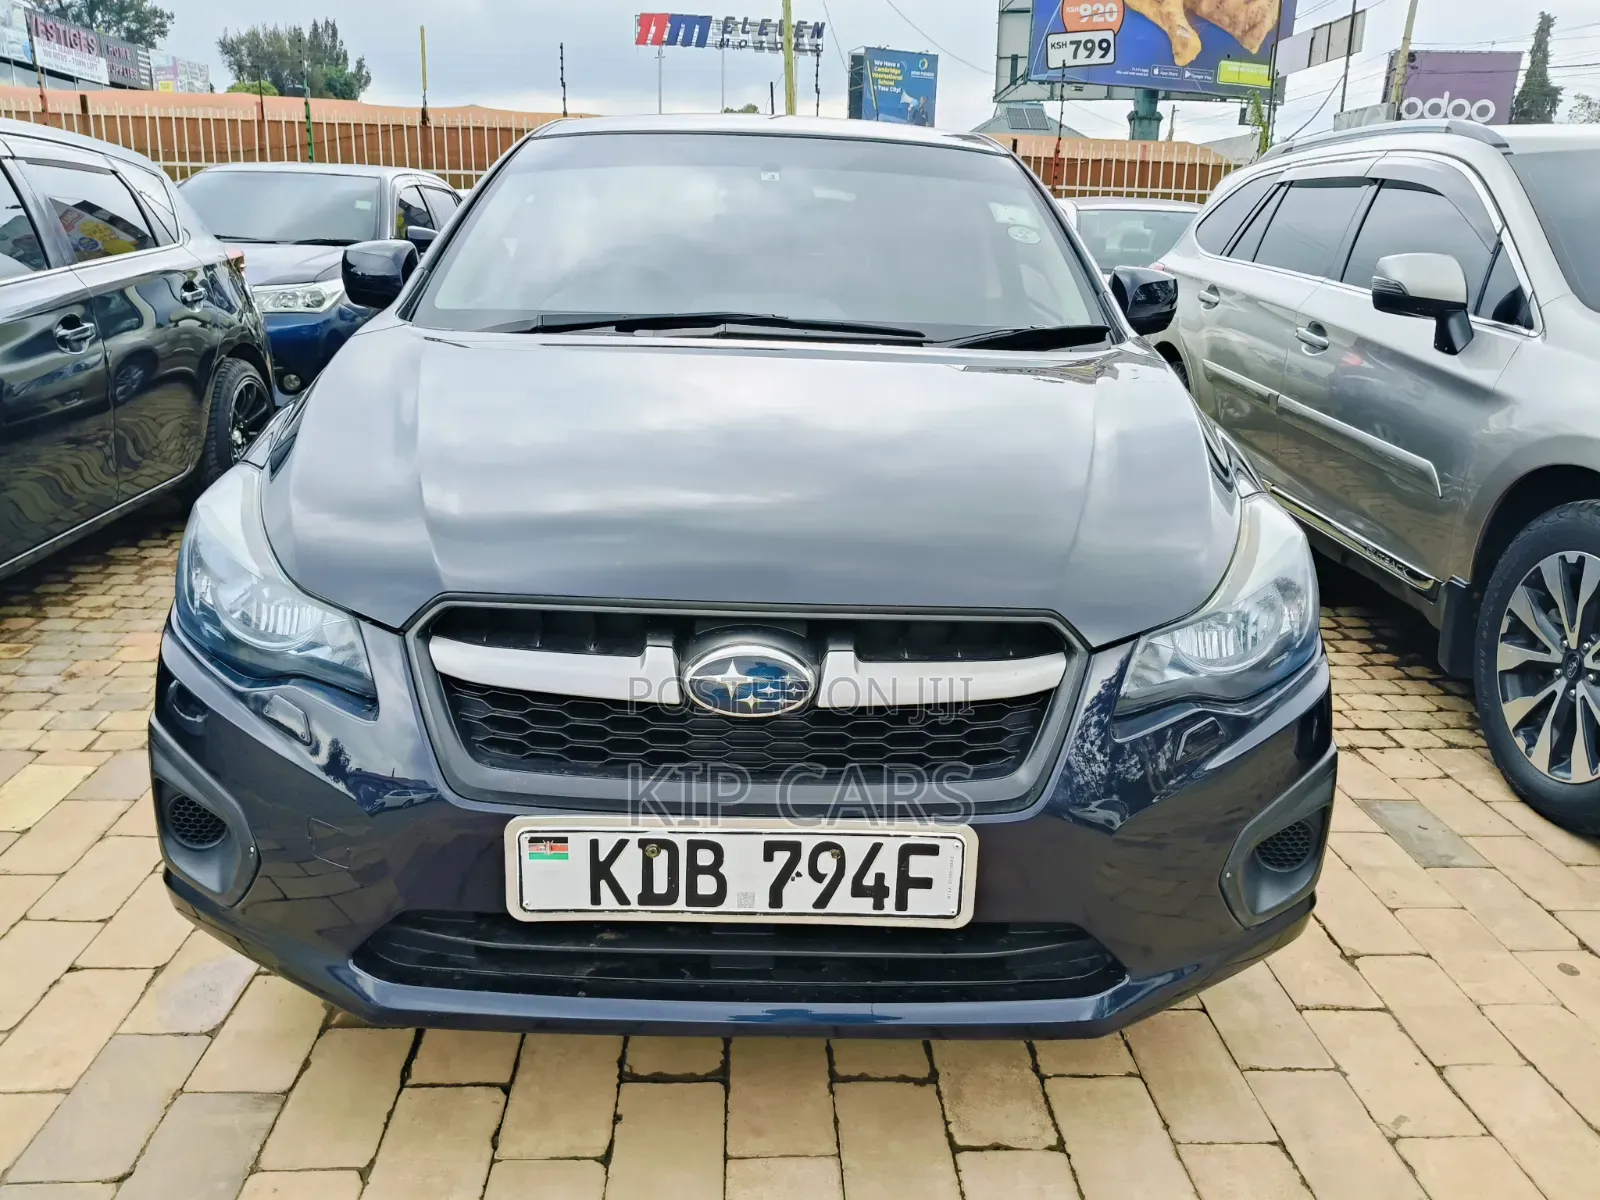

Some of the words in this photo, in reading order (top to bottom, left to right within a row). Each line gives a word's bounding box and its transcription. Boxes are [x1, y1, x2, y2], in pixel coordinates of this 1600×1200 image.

[1079, 2, 1119, 23] 920
[107, 44, 131, 60] HOME
[1050, 40, 1068, 50] KSH
[1069, 38, 1112, 60] 799
[872, 72, 904, 80] International
[874, 66, 901, 75] Cambridge
[1400, 90, 1496, 123] odoo
[589, 837, 728, 908] KDB
[762, 839, 940, 912] 794F
